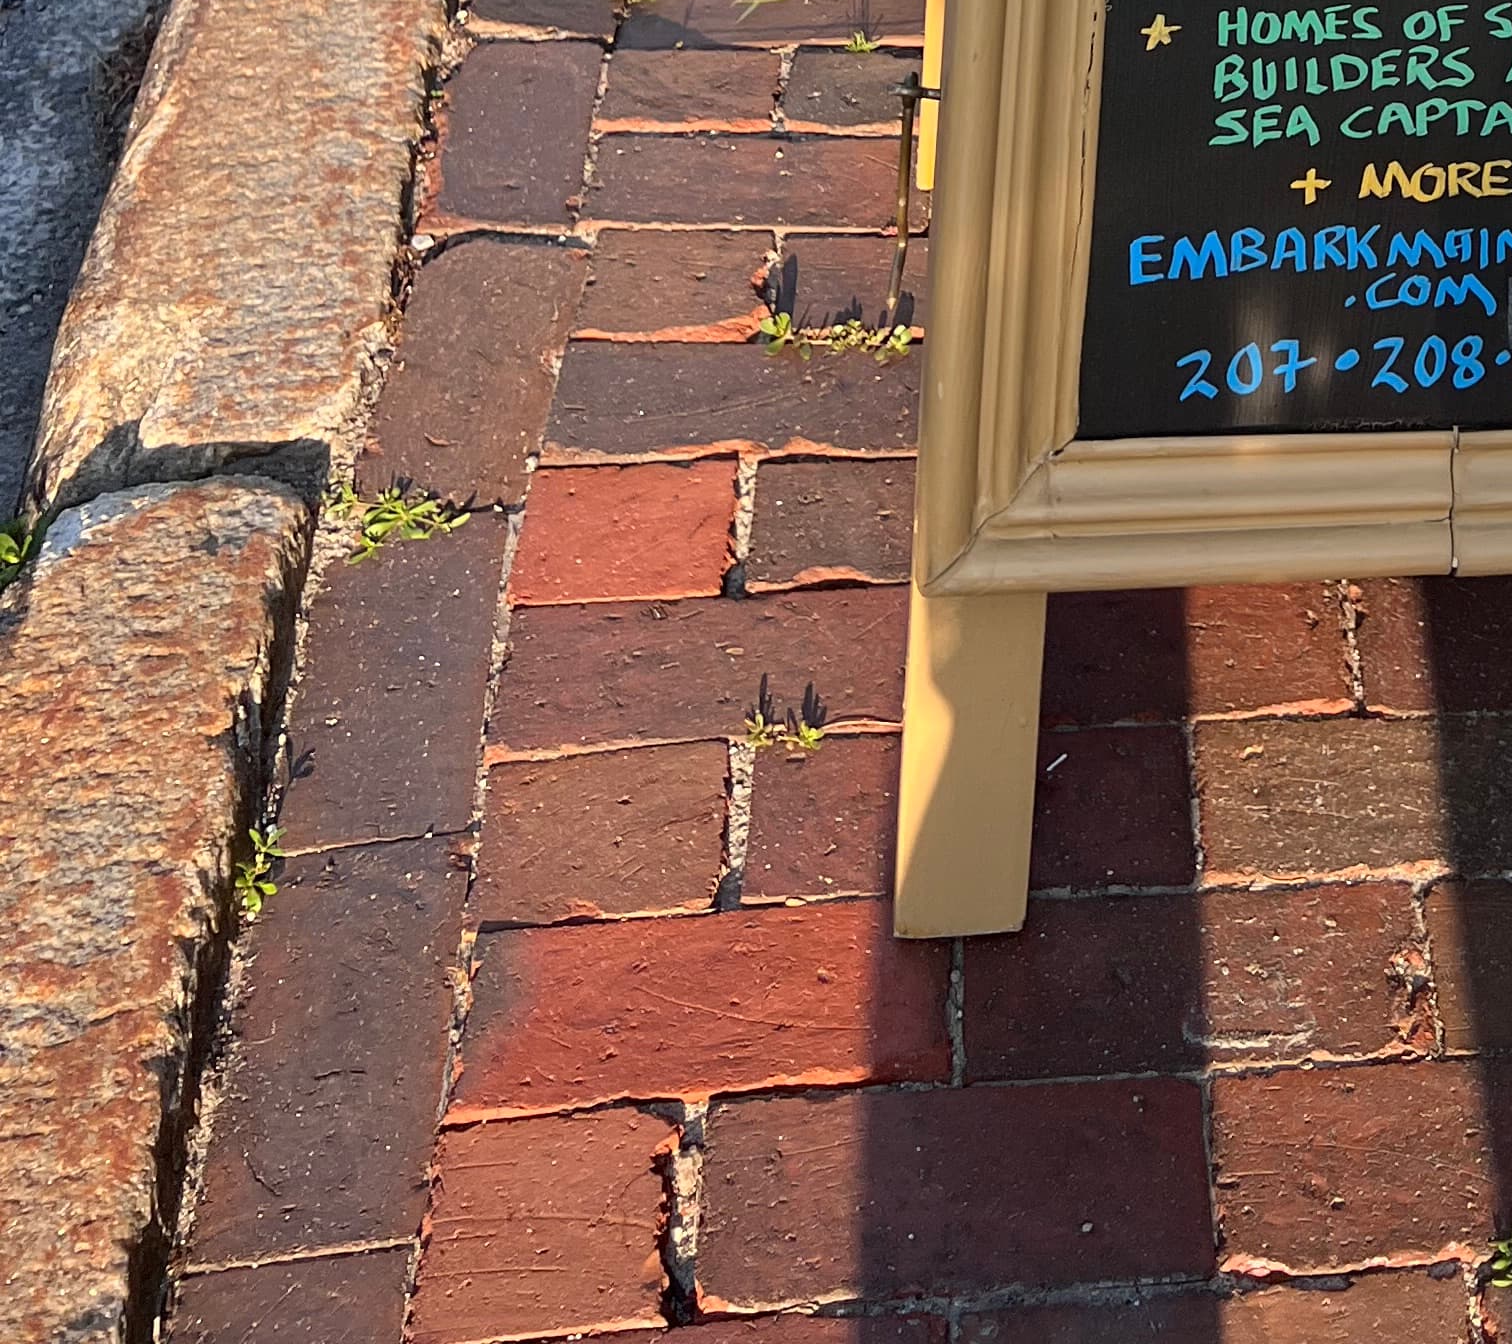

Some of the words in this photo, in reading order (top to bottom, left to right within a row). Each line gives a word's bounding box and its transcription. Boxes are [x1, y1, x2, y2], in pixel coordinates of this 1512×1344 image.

[1217, 4, 1382, 46] HOMES
[1403, 4, 1469, 42] OF
[1213, 46, 1476, 102] BUILDERS
[1209, 106, 1320, 148] SEA
[1344, 274, 1496, 316] .COM
